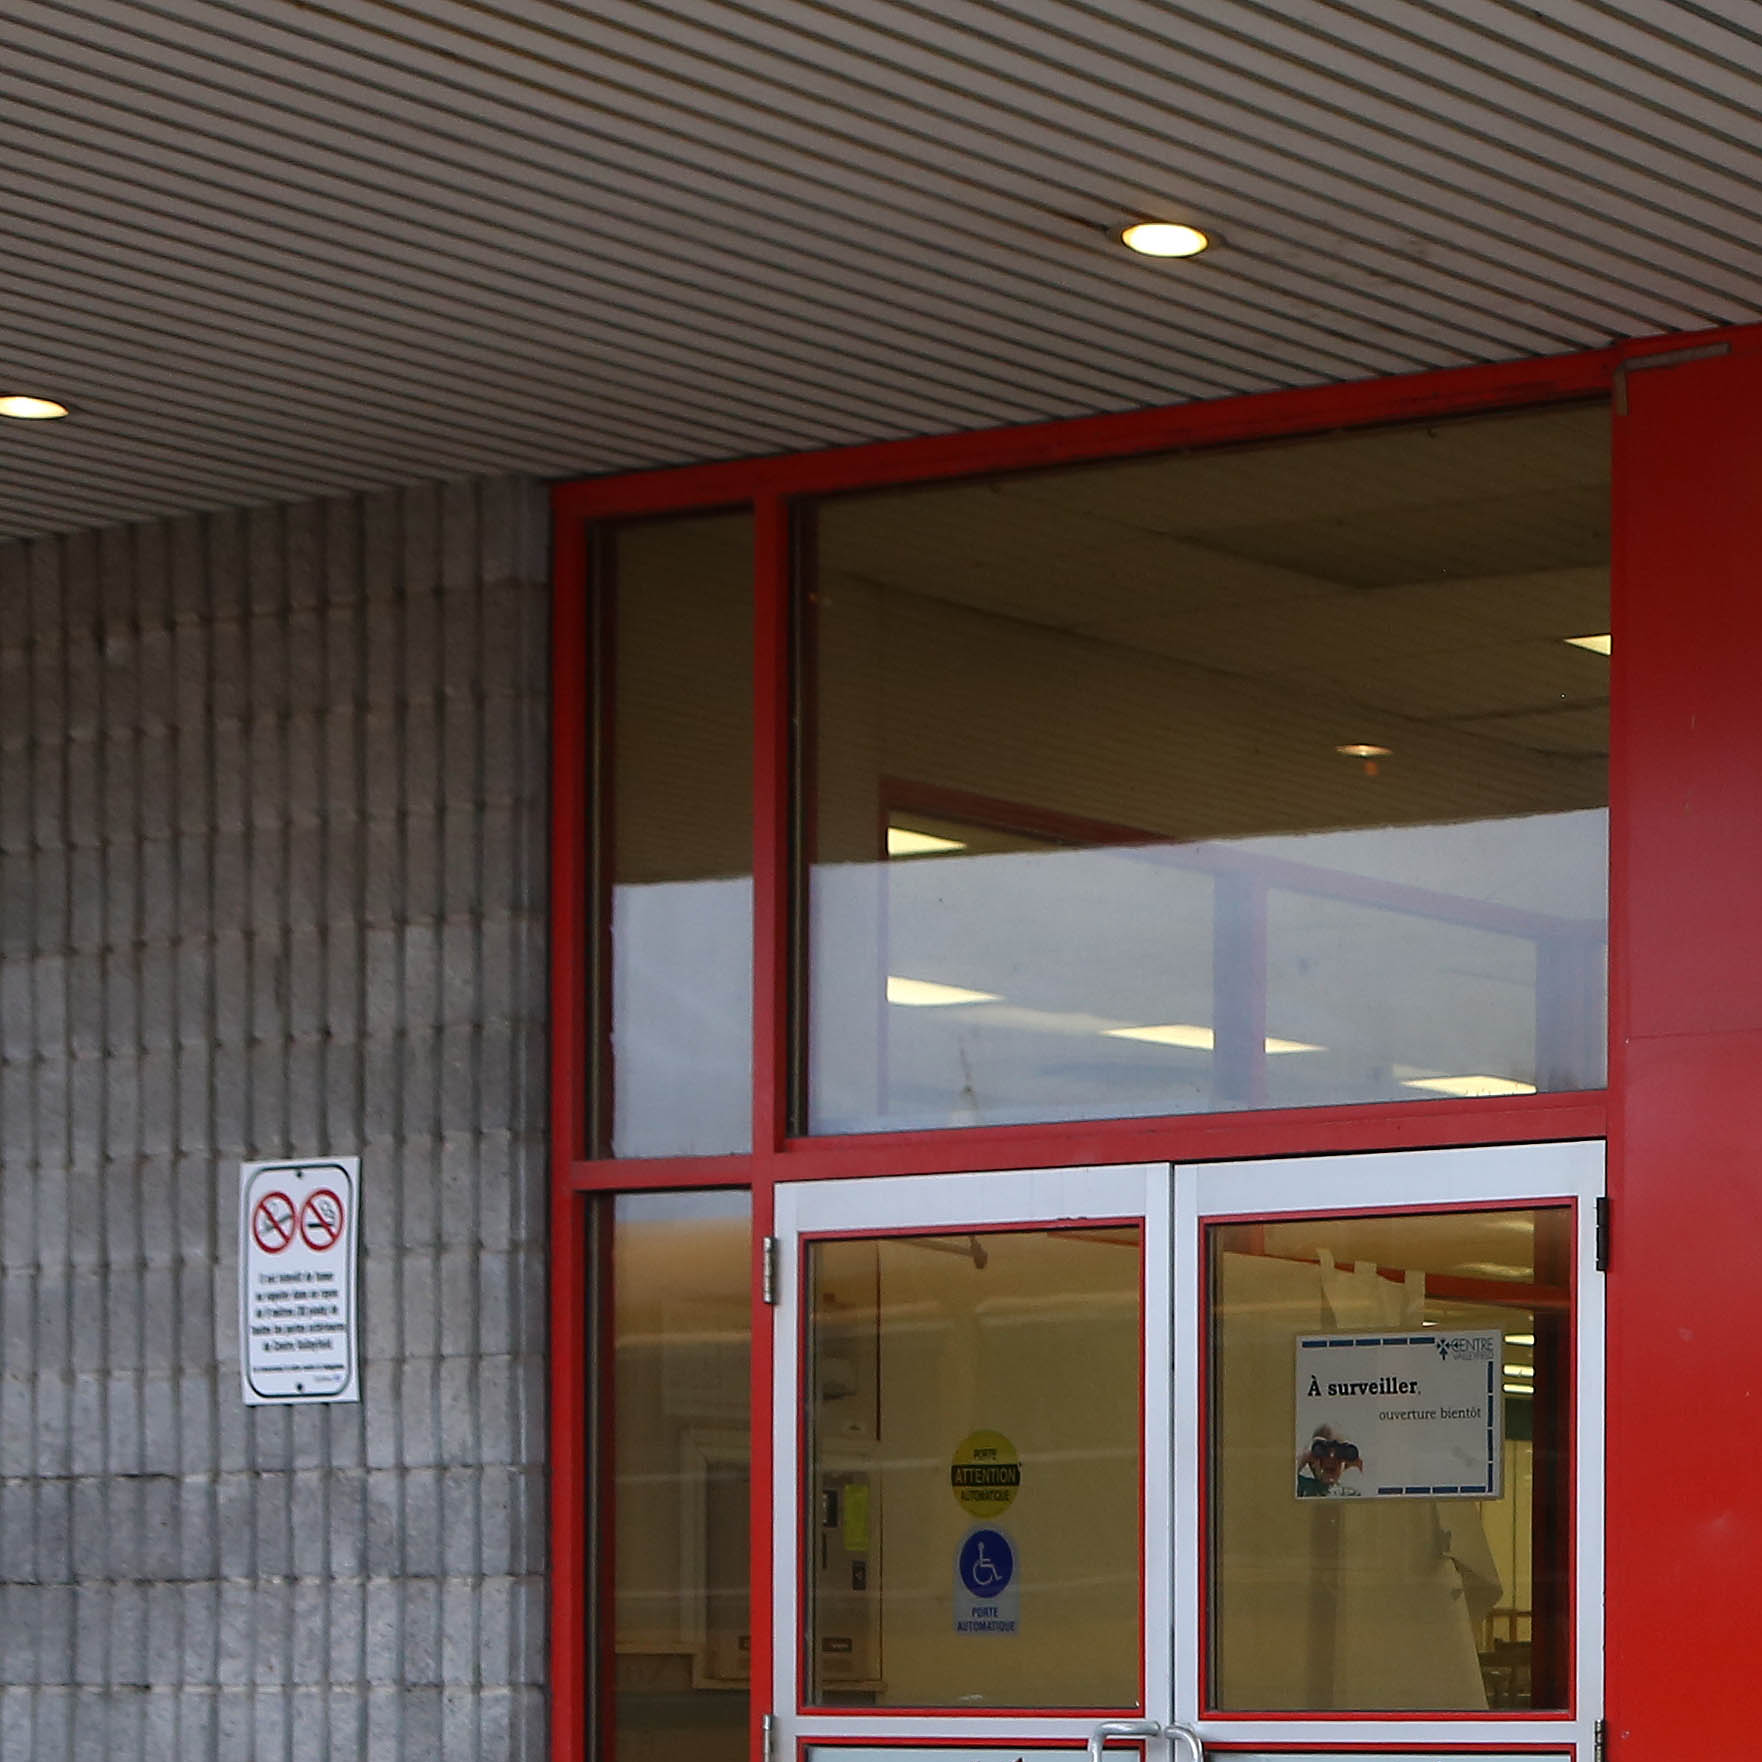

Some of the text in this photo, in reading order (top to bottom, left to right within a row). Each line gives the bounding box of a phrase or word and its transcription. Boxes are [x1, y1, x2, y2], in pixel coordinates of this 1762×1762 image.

[1451, 1337, 1495, 1352] CENTRE
[1307, 1374, 1322, 1397] À
[1378, 1407, 1482, 1421] ouverture bientôt
[954, 1467, 1017, 1484] ATTENTION
[971, 1607, 999, 1618] PORTE
[957, 1620, 1016, 1633] AUTOMATIQUE
